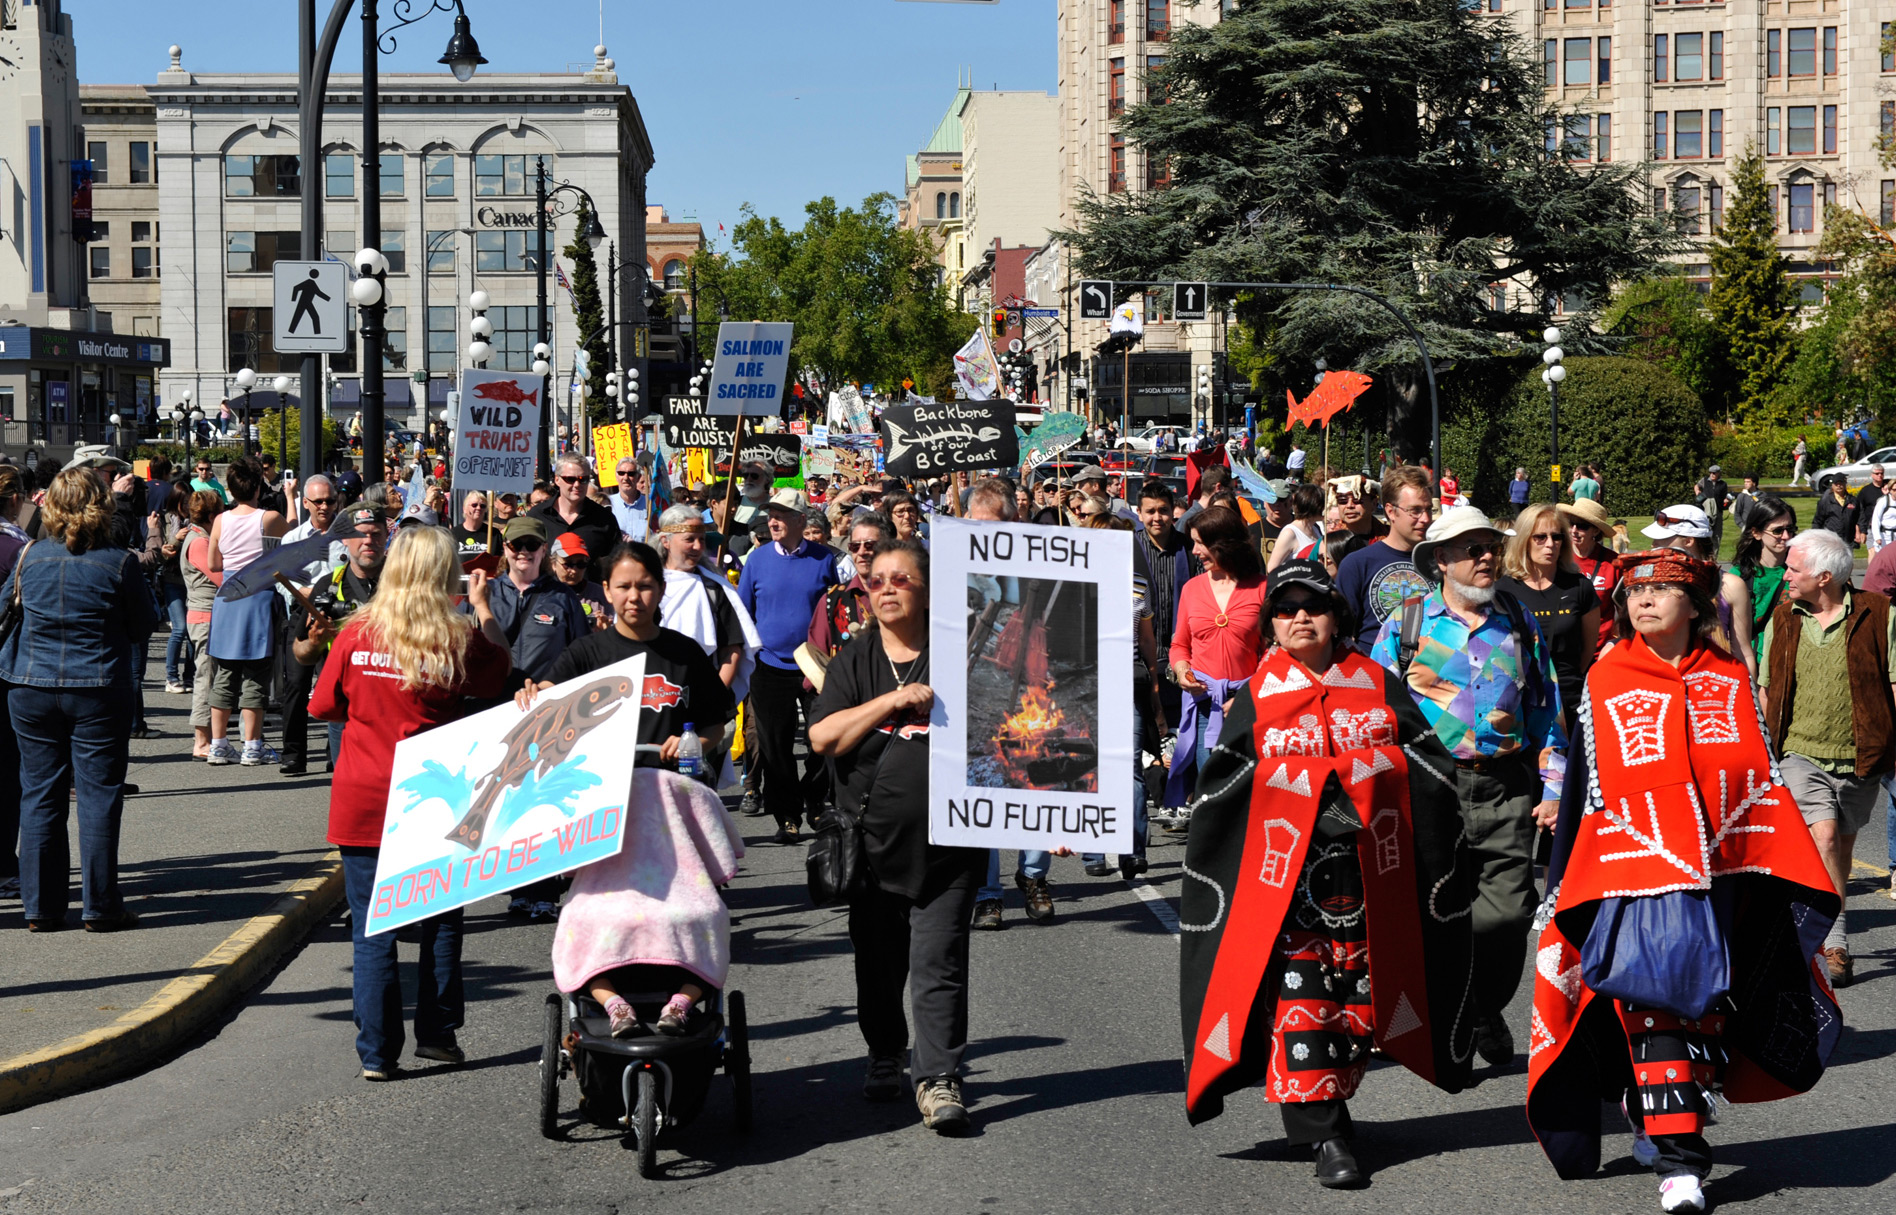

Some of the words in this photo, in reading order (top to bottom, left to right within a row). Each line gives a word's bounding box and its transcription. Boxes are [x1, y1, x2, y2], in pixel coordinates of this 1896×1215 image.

[1024, 310, 1051, 318] Humboldt
[1176, 310, 1204, 318] Government
[78, 340, 103, 356] Visitor
[104, 342, 129, 358] Centre
[722, 340, 784, 356] SALMON
[735, 362, 764, 377] ARE
[52, 387, 65, 397] ATM
[717, 383, 777, 399] SACRED
[669, 398, 706, 415] FARM
[914, 404, 992, 422] Backbone
[470, 406, 522, 428] WILD
[693, 417, 718, 431] ARE
[465, 429, 532, 453] TRUMPS
[682, 430, 735, 446] LOUSEY
[931, 440, 943, 451] of
[949, 441, 970, 450] our
[954, 449, 998, 464] Coast
[457, 455, 532, 478] OPEN-NET
[969, 531, 1014, 562] NO
[1023, 533, 1089, 569] FISH
[351, 651, 371, 666] GET
[371, 651, 392, 668] OUT
[949, 798, 994, 829] NO
[1004, 802, 1117, 838] FUTURE
[372, 863, 454, 920] BORN
[463, 846, 501, 888] TO
[506, 832, 544, 875] BE
[551, 807, 620, 855] WILD
